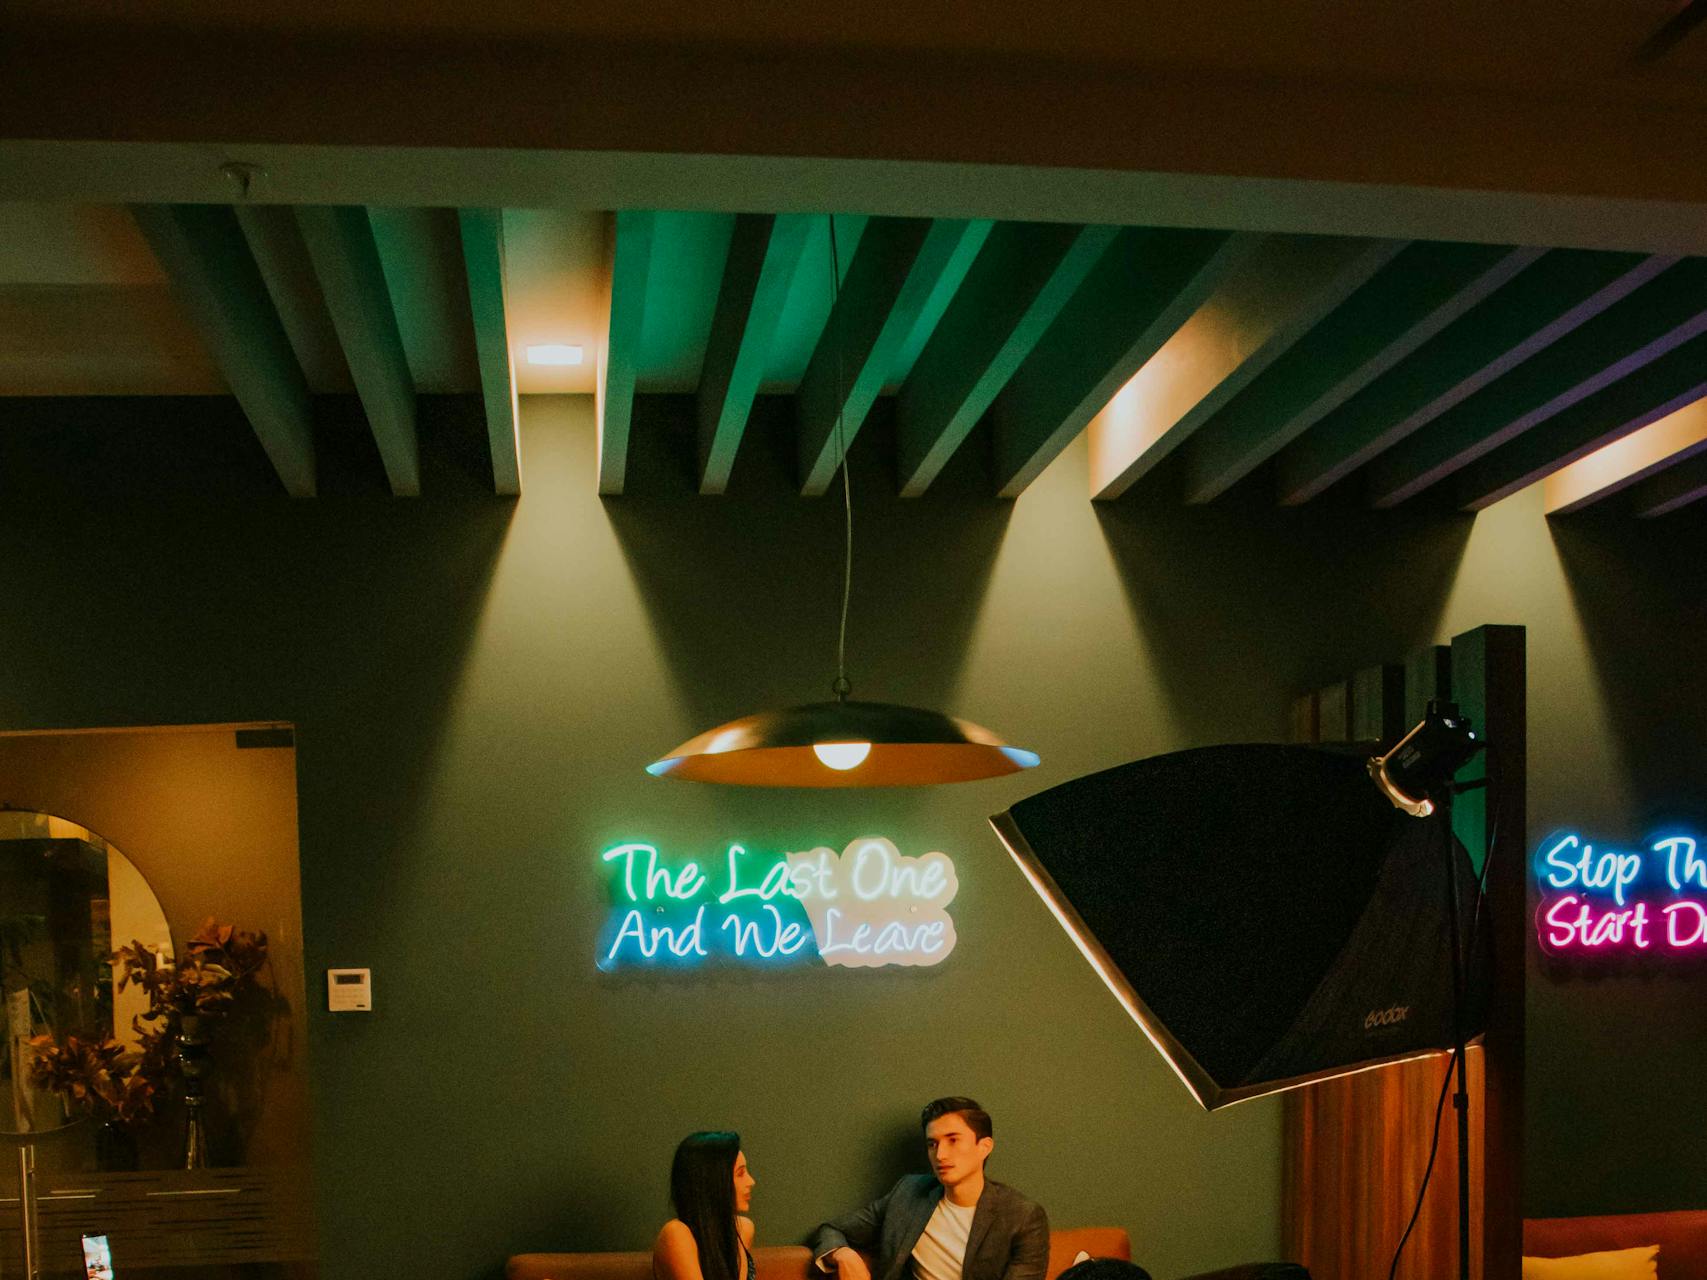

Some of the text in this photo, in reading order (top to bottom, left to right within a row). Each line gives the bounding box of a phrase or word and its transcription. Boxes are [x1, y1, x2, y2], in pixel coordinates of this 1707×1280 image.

[603, 841, 947, 904] The Last One
[1547, 835, 1641, 906] Stop
[608, 904, 945, 959] And We Leave
[1546, 896, 1649, 947] Start
